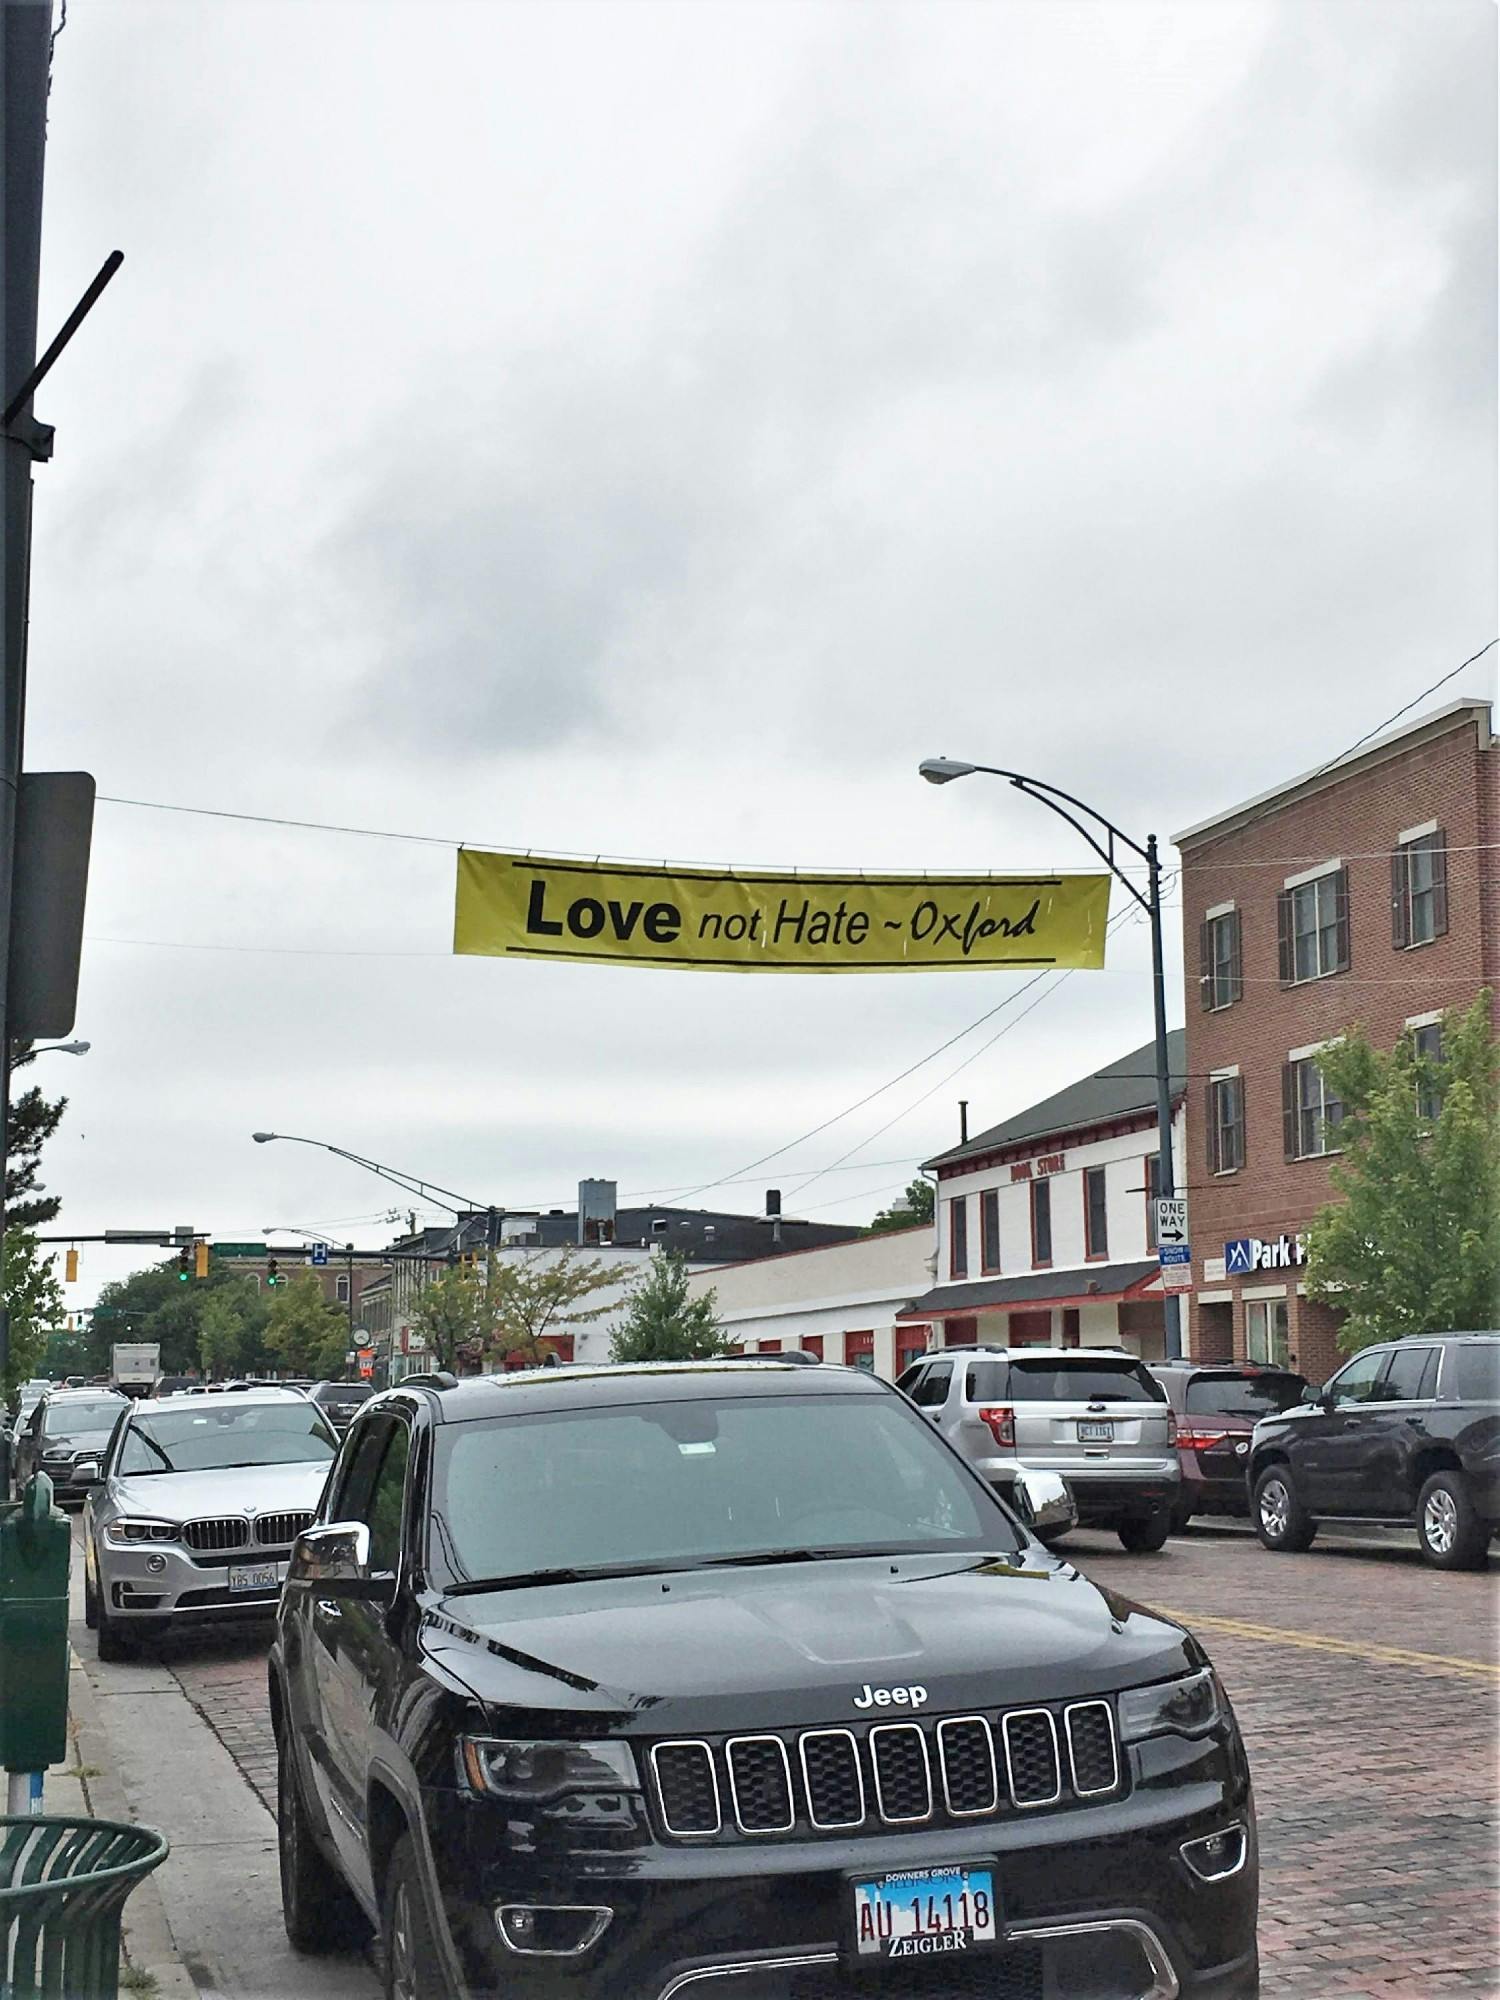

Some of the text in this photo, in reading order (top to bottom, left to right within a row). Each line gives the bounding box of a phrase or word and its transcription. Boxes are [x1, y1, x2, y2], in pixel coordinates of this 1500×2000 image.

[527, 880, 681, 943] Love
[698, 907, 761, 941] not
[773, 899, 869, 945] Hate
[1160, 1203, 1185, 1214] ONE
[1160, 1216, 1185, 1227] WAY
[1251, 1235, 1291, 1270] Park
[853, 1684, 928, 1709] Jeep
[886, 1866, 961, 1882] DOWNERS GROVE
[861, 1890, 989, 1942] AU 14118
[889, 1929, 967, 1957] ZEIGLER
